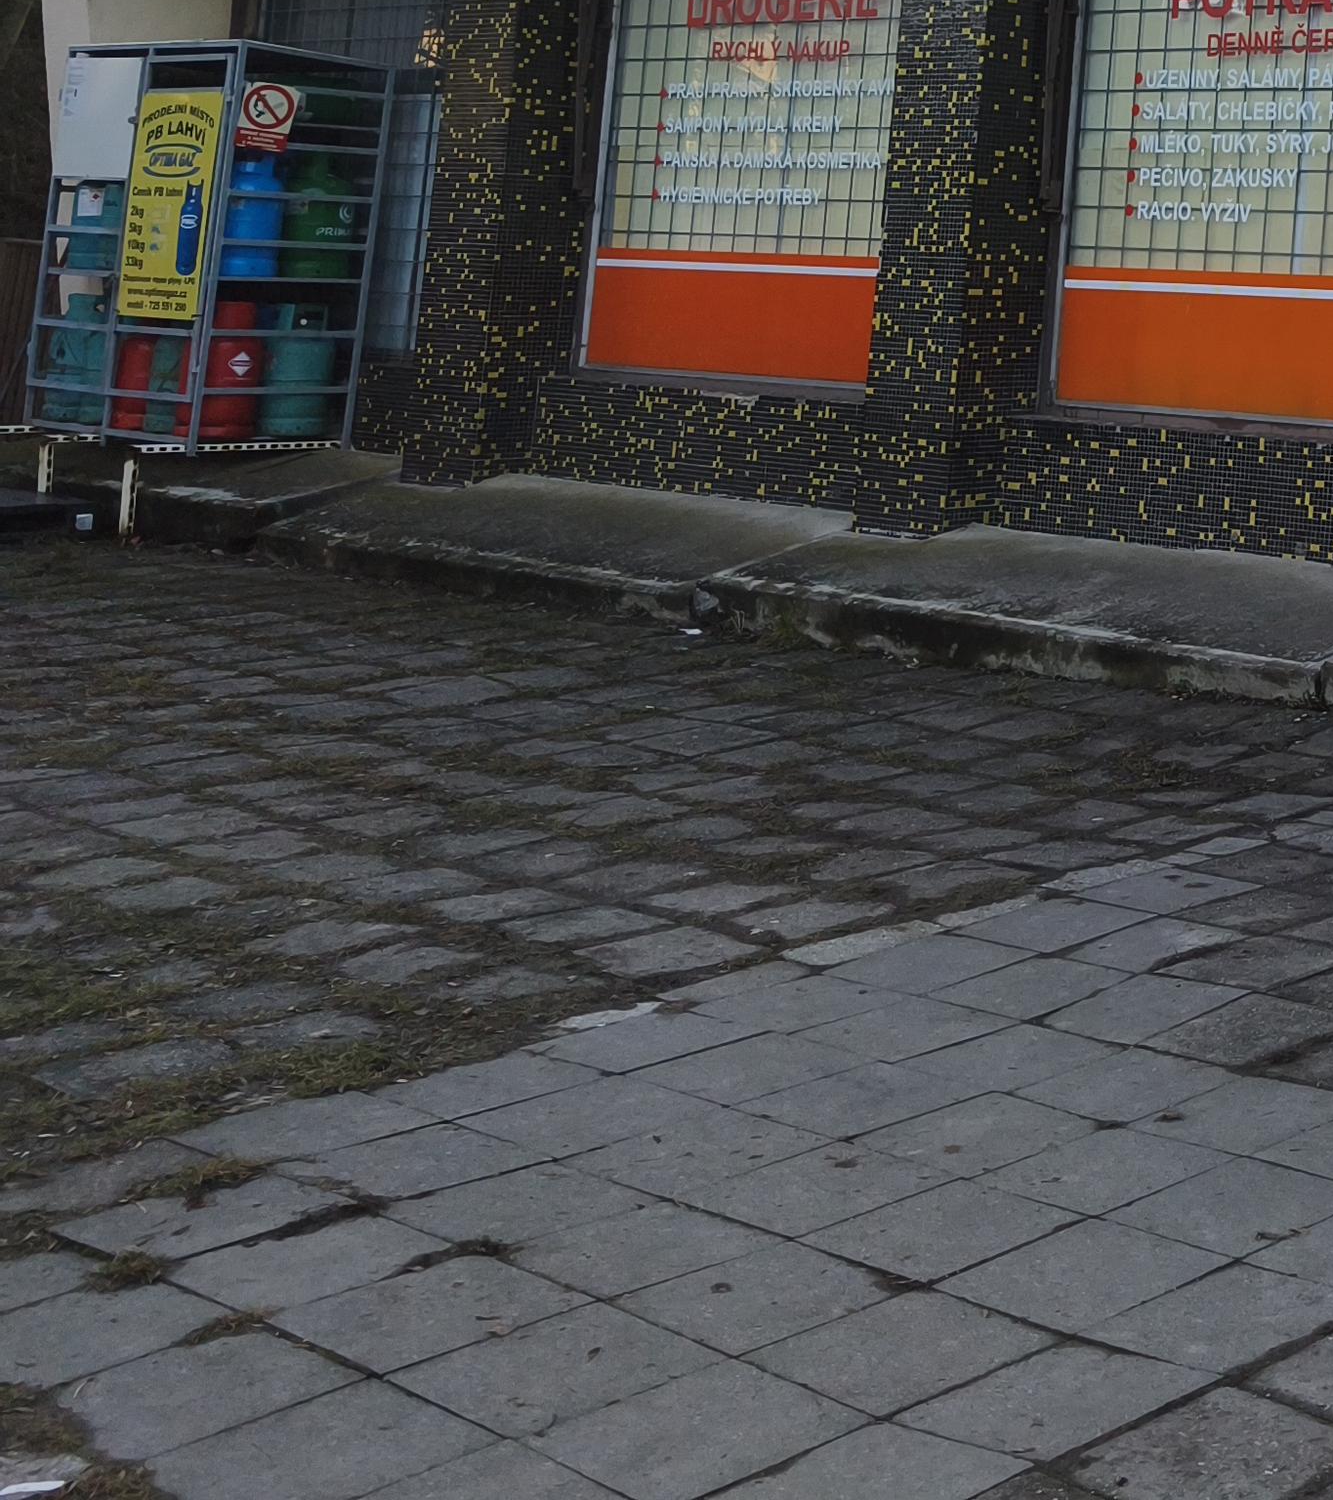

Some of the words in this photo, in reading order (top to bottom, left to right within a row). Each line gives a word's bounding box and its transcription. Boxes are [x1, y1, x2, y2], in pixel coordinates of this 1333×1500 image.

[712, 37, 782, 61] RYCHLÝ
[787, 37, 850, 62] NÁKUP
[1207, 25, 1284, 57] DENNĚ
[1145, 68, 1222, 91] UZENINY,
[1227, 64, 1302, 91] SALÁMY,
[146, 124, 164, 146] PB
[167, 120, 206, 146] LAHVÍ
[1140, 130, 1205, 156] MLÉKO,
[1211, 133, 1260, 157] TUKY,
[1266, 129, 1316, 156] SÝRY,
[799, 152, 882, 170] KOSMETIKA
[1139, 163, 1207, 190] PEČIVO,
[1211, 164, 1298, 189] ZÁKUSKY
